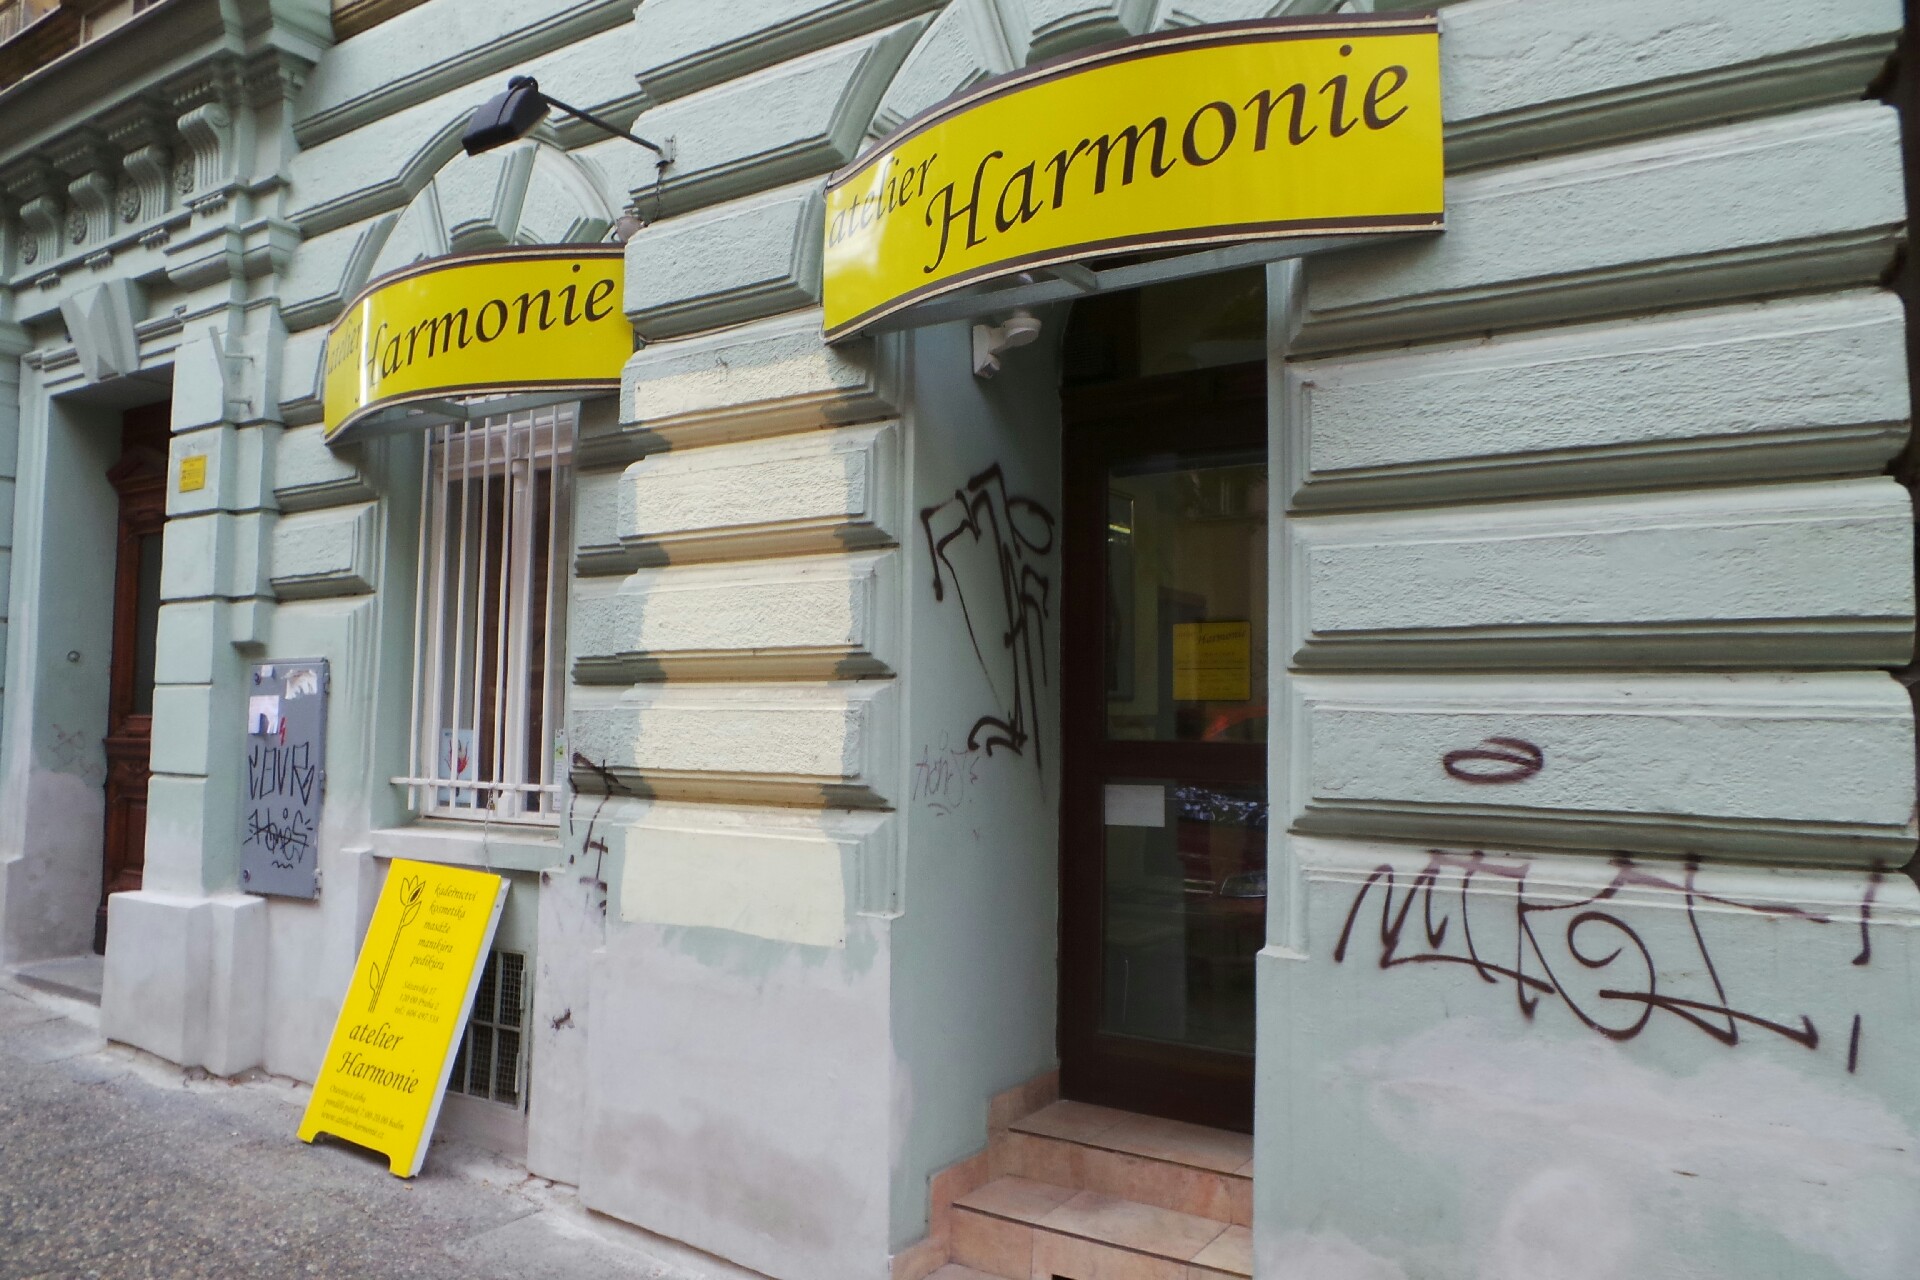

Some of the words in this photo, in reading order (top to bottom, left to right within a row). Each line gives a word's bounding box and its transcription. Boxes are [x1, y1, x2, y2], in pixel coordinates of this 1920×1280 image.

[922, 44, 1409, 275] Harmonie
[827, 152, 937, 249] atelier
[429, 900, 466, 920] kosmetika
[348, 1022, 404, 1051] atelier
[336, 1051, 419, 1094] Harmonie
